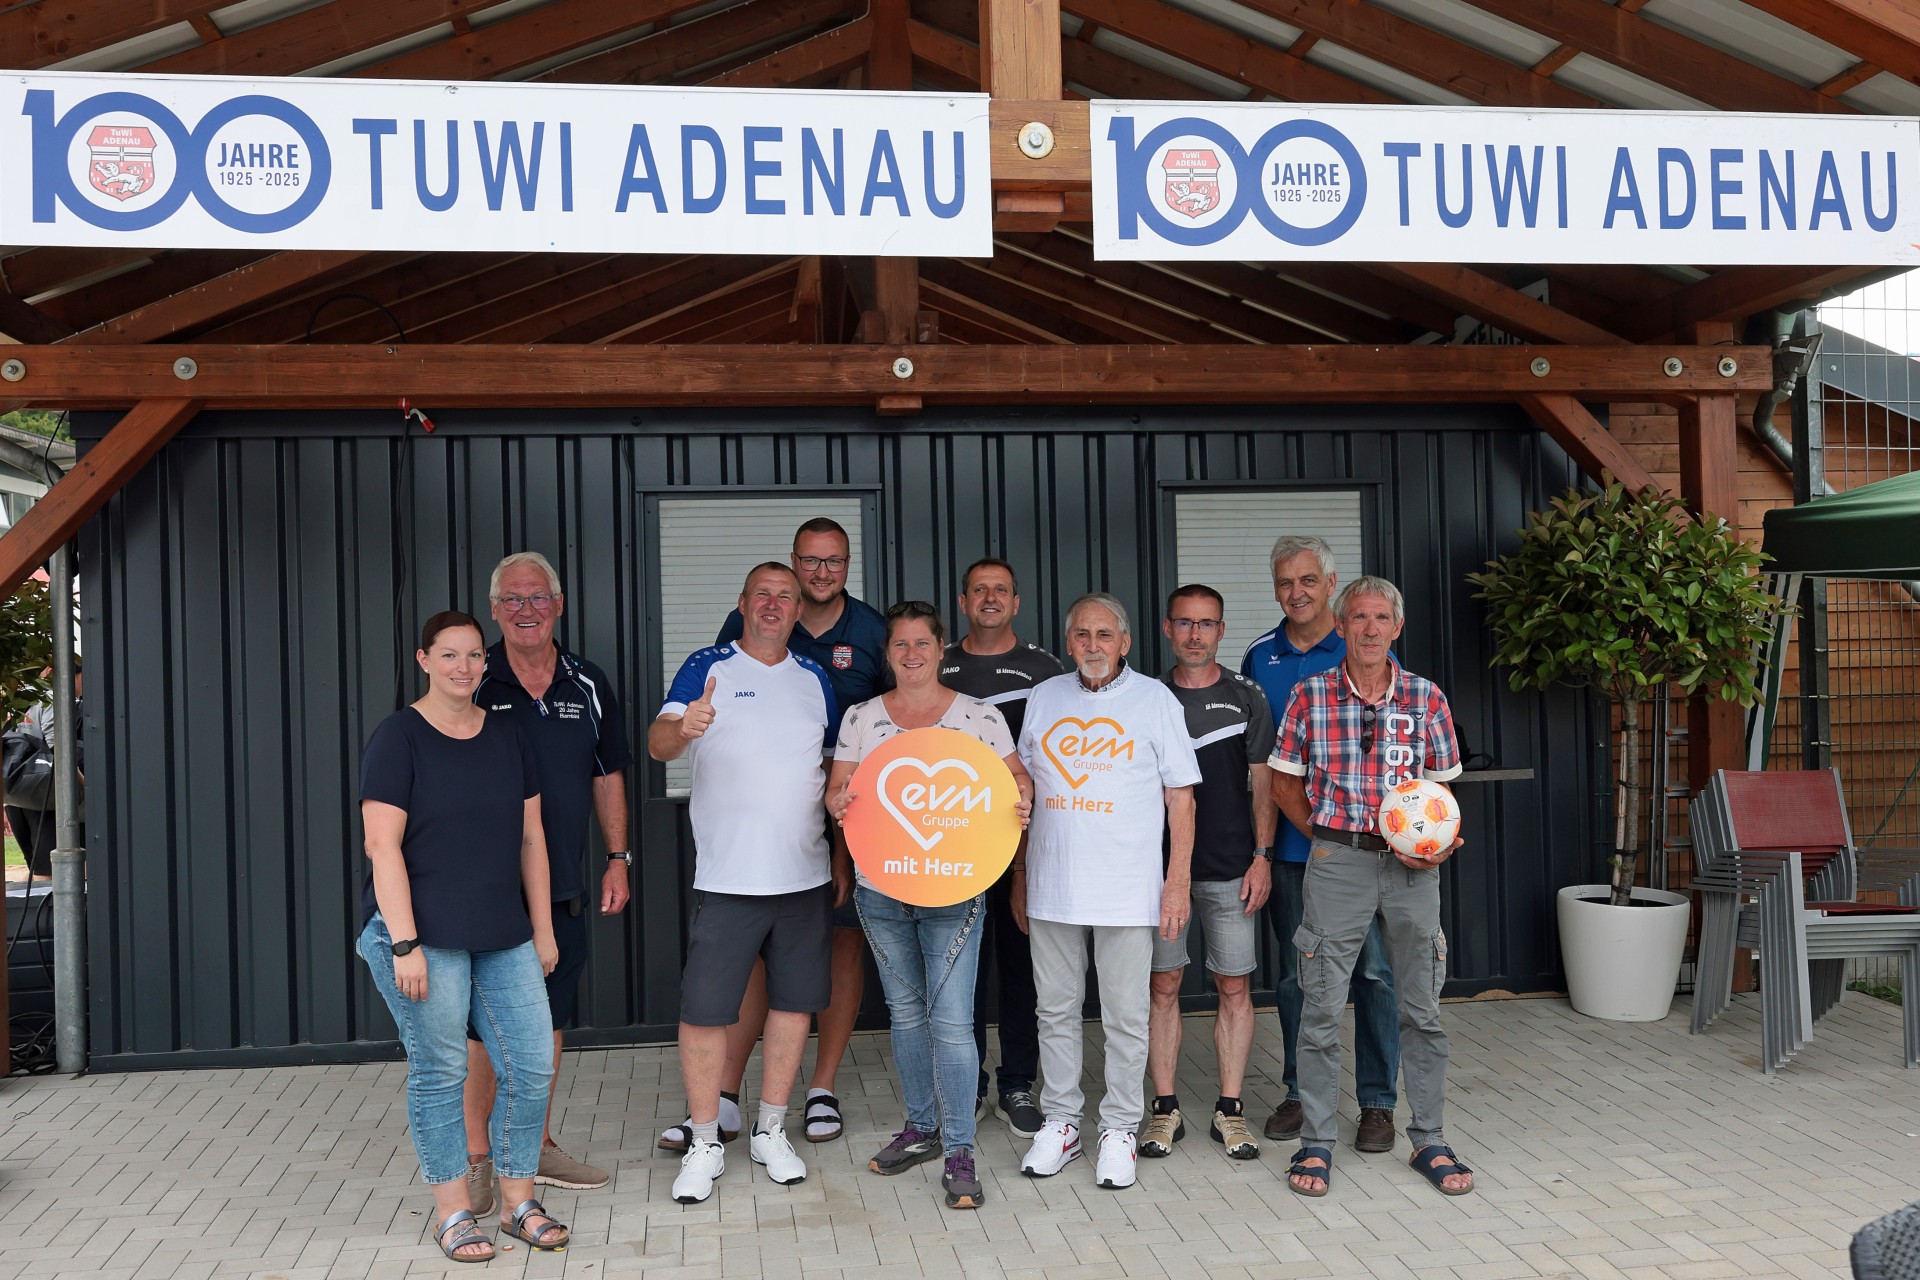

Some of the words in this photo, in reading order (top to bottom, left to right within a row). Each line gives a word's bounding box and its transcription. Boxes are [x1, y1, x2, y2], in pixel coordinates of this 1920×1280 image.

[103, 137, 140, 145] ADENAU
[21, 89, 332, 234] 100
[218, 143, 299, 169] JAHRE
[219, 172, 253, 186] 1925
[352, 118, 573, 212] TUWI
[615, 123, 966, 219] ADENAU
[1271, 162, 1340, 187] JAHRE
[1107, 116, 1367, 247] 100
[1383, 142, 1568, 229] TUWI
[1603, 146, 1898, 232] ADENAU
[1273, 189, 1302, 203] 1925
[942, 666, 960, 675] JAKO
[1058, 735, 1135, 761] evm
[1073, 759, 1113, 773] Gruppe
[901, 783, 992, 813] evm
[1045, 793, 1067, 810] mit
[1072, 795, 1114, 813] Herz
[922, 814, 970, 829] Gruppe
[884, 855, 918, 875] mit
[924, 858, 974, 877] Herz
